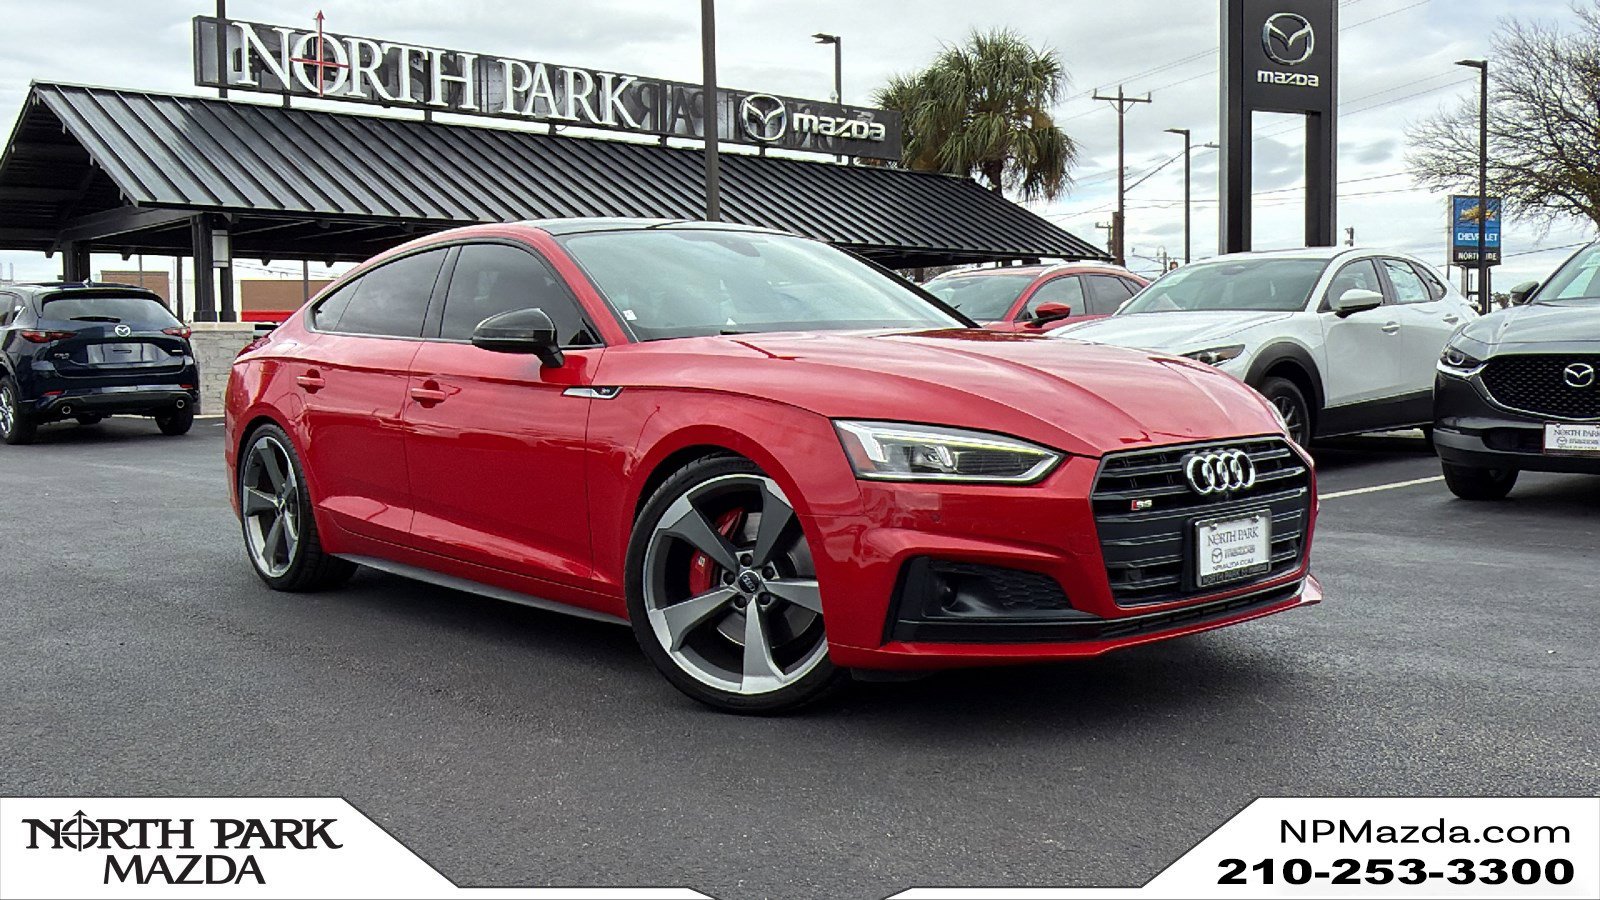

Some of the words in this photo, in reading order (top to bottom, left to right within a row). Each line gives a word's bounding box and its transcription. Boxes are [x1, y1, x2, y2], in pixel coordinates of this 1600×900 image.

[231, 22, 479, 111] NORTH
[497, 58, 641, 129] PARK
[1257, 69, 1319, 87] mazda
[793, 112, 886, 142] mazda
[1457, 232, 1498, 241] CHEVRLET
[1207, 530, 1236, 546] NORTH
[1238, 526, 1259, 540] PARK
